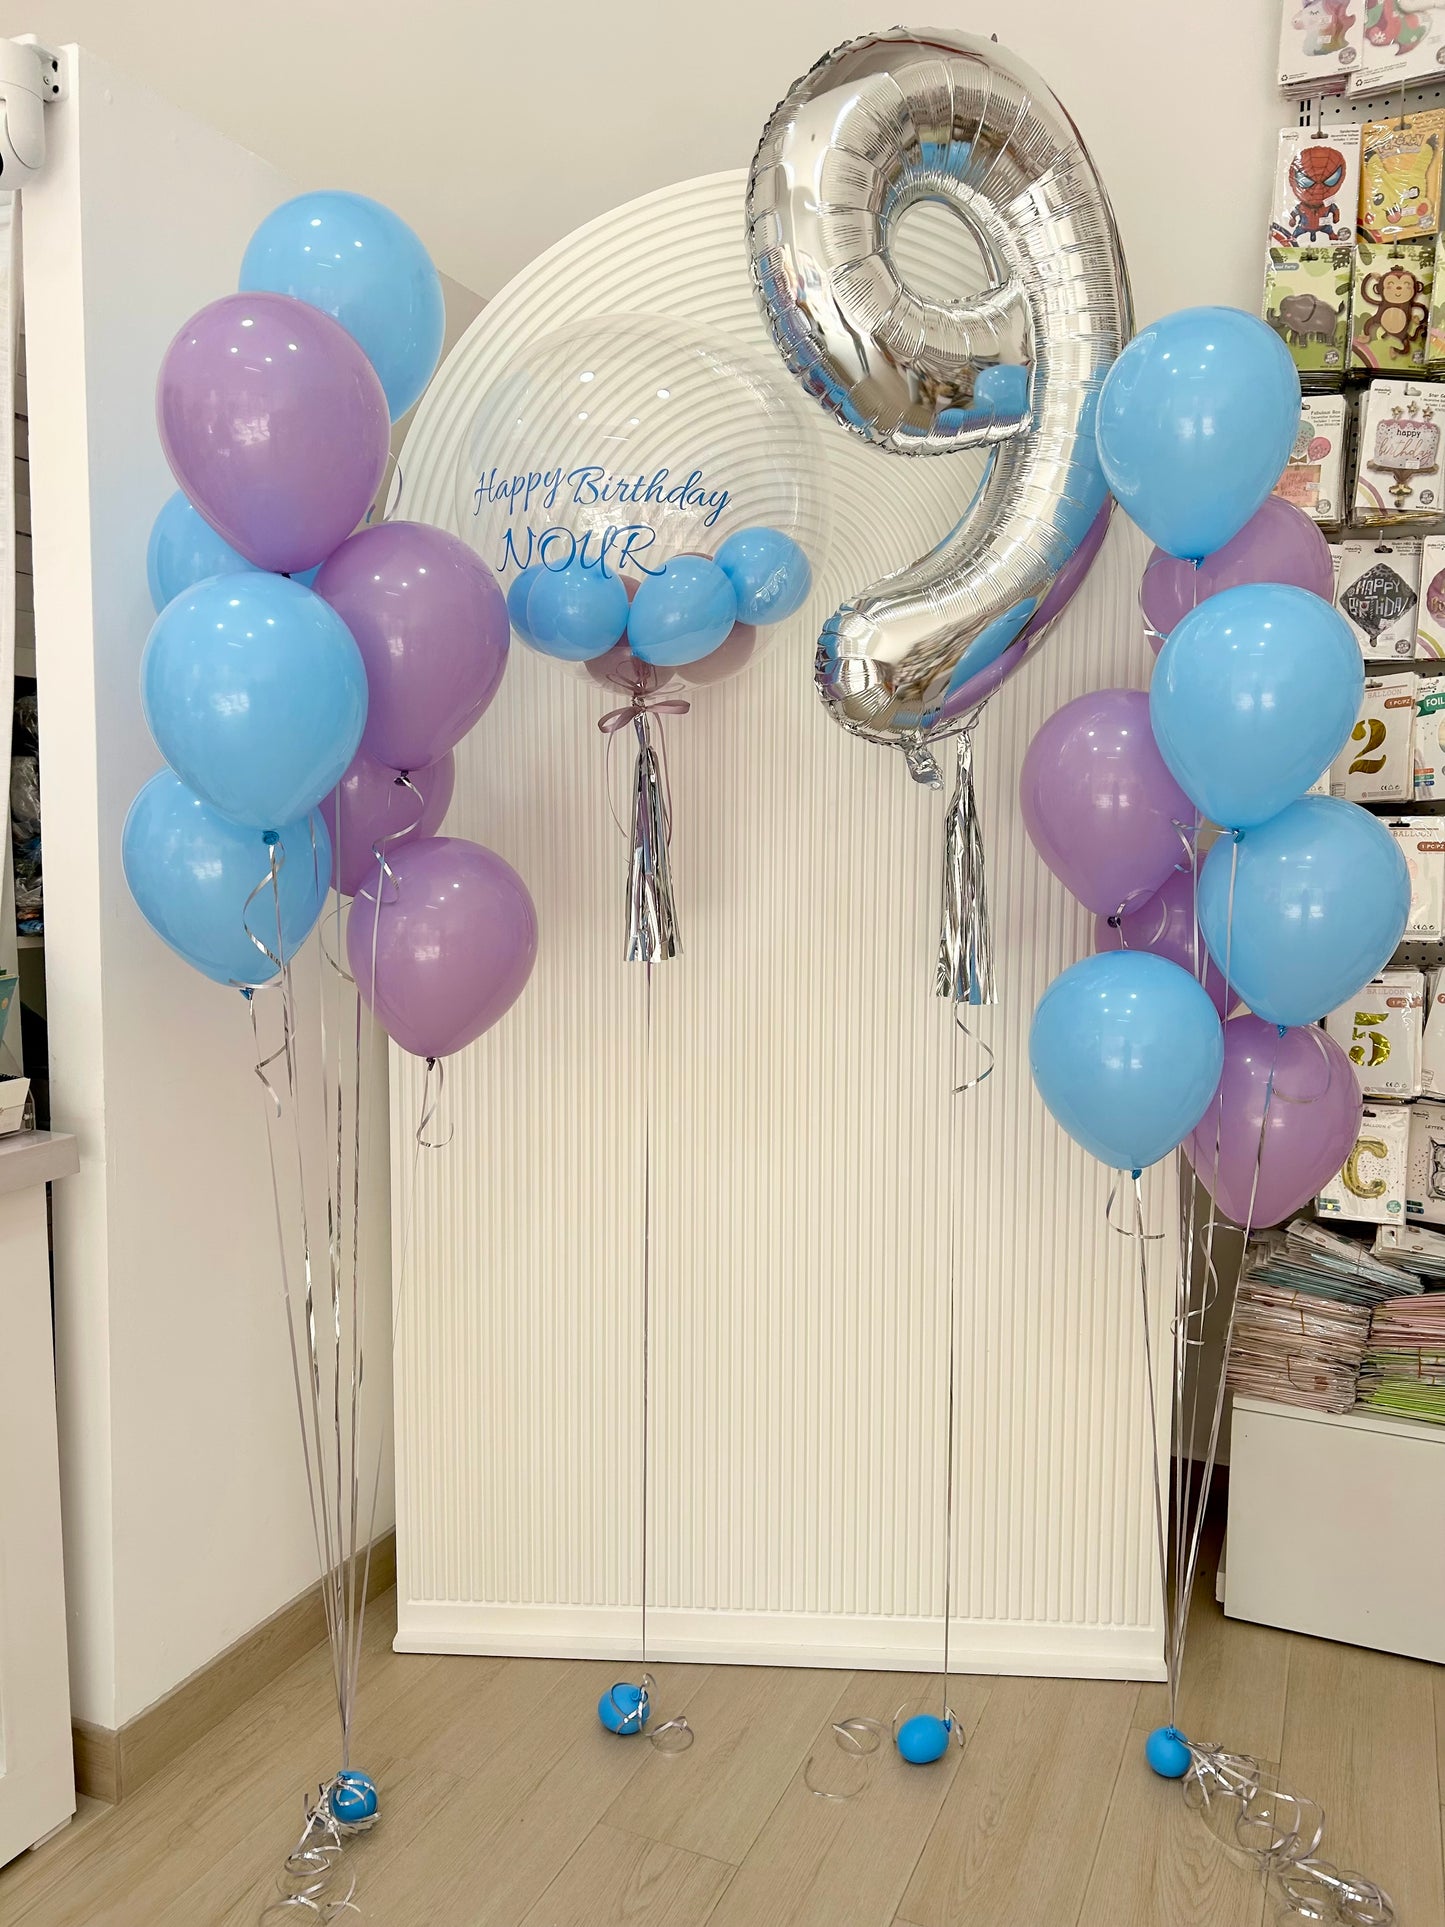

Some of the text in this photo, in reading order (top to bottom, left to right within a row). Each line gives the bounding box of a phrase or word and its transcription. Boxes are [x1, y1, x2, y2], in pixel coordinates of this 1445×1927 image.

[1396, 429, 1421, 438] happy
[1378, 438, 1433, 466] birthday
[473, 466, 732, 527] Happy Birthday
[496, 525, 667, 579] NOUR
[1356, 578, 1400, 595] HAPPY
[1367, 689, 1402, 699] BALLOON
[1426, 697, 1445, 707] FOIL
[1349, 719, 1386, 774] 2
[1349, 1011, 1391, 1066] 5
